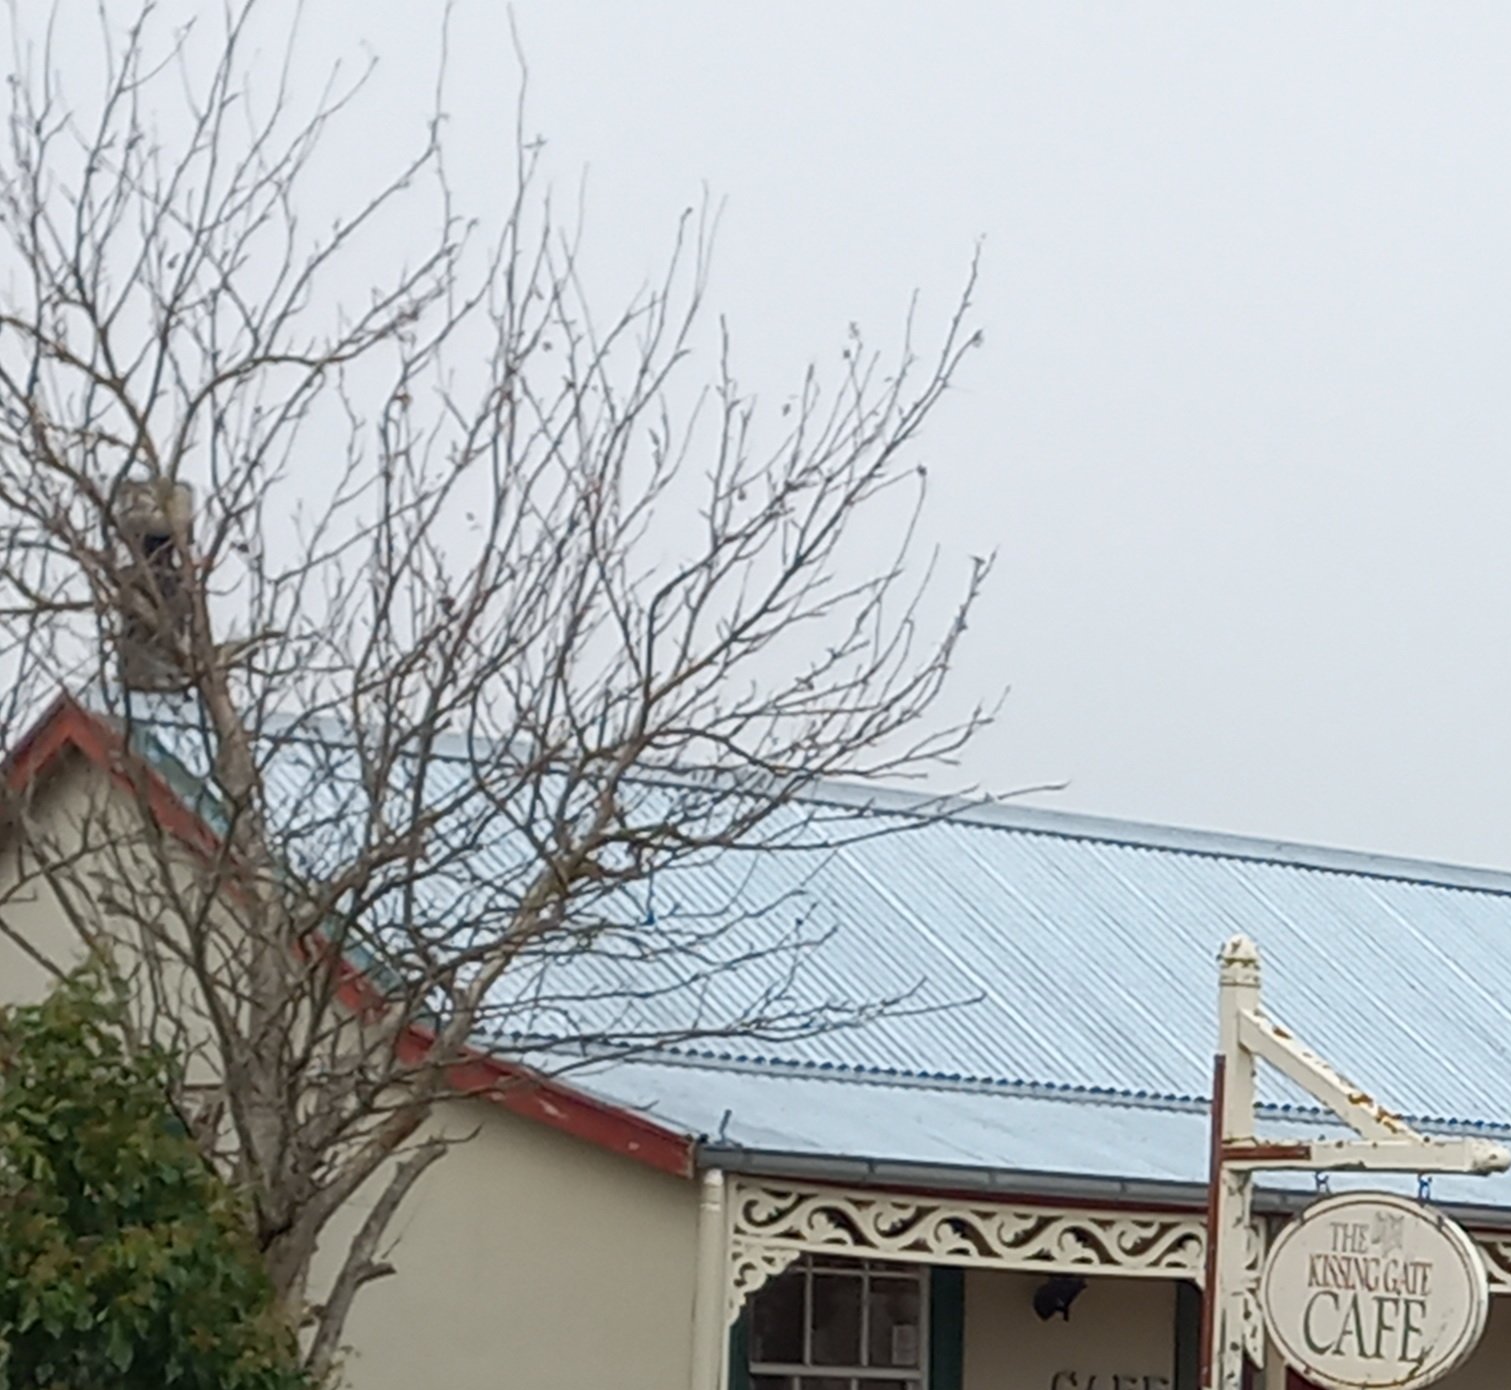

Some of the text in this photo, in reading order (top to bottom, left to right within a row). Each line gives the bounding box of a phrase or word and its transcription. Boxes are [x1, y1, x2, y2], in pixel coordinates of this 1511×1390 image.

[1330, 1221, 1370, 1254] THE
[1307, 1253, 1433, 1296] KISSING GATE
[1303, 1290, 1427, 1362] CAFE
